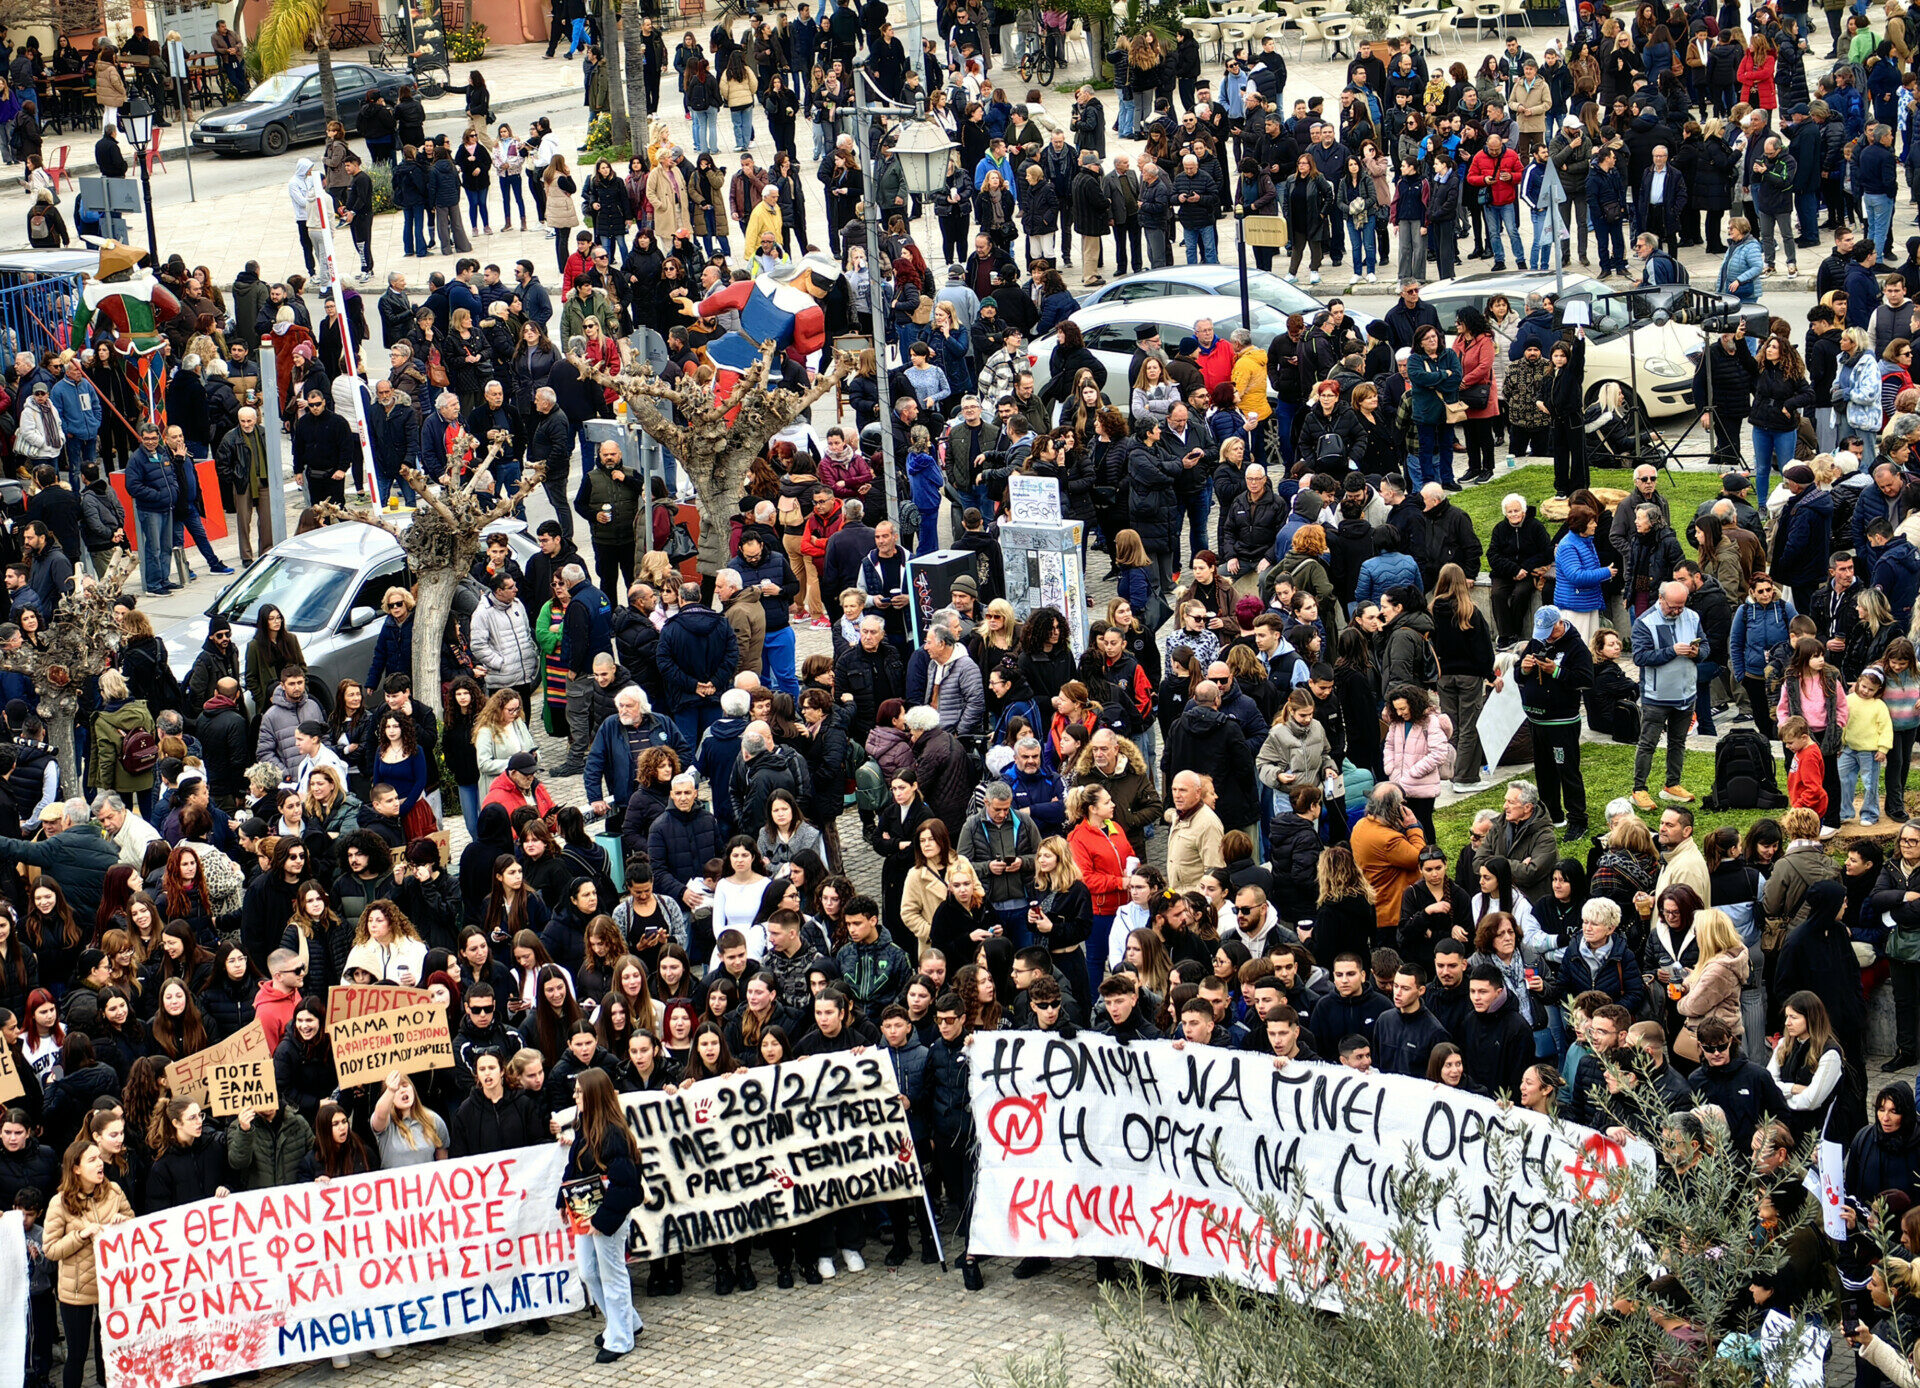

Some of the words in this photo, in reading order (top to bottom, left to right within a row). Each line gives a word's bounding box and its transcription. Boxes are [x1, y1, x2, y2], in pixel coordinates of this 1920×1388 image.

[334, 1017, 388, 1041] ΜΑΜΑ
[397, 1010, 436, 1027] ΜΟΥ
[336, 1034, 393, 1059] ΑΦΑΙΡΕΣΑΝ
[393, 1032, 405, 1044] ΤΟ
[215, 1062, 262, 1080] ΠΟΤΕ
[220, 1080, 263, 1096] ΞΑΝΑ
[340, 1057, 363, 1076] ΠΟΥ
[367, 1051, 387, 1069] ΕΣΥ
[389, 1047, 412, 1064] ΜΟΥ
[413, 1042, 452, 1057] ΧΑΡΙΣΕΣ
[718, 1058, 882, 1120] 28/2/23
[219, 1092, 274, 1110] ΤΕΜΠΗ
[982, 1037, 1025, 1099] Η
[1036, 1039, 1162, 1106] ΘΛΙΨΗ
[1178, 1054, 1253, 1121] ΝΑ
[1272, 1070, 1386, 1146] ΓΙΝΕΙ
[1422, 1100, 1552, 1188] ΟΡΓΗ
[669, 1127, 725, 1170] ΜΕ
[731, 1109, 795, 1151] ΟΤΑΝ
[796, 1094, 905, 1139] ΦΤΑΣΕΙΣ
[1058, 1105, 1103, 1167] Η
[1122, 1112, 1232, 1188] ΟΡΓΗ
[1254, 1134, 1314, 1200] ΝΑ
[686, 1155, 775, 1198] ΡΑΓΕΣ
[787, 1130, 904, 1177] ΓΕΜΙΣΑΝ
[99, 1219, 169, 1269] ΜΑΣ
[184, 1191, 312, 1247] ΘΕΛΑΝ
[385, 1200, 506, 1253] ΝΙΚΗΣΕ
[1008, 1176, 1145, 1242] ΚΑΜΙΑ
[106, 1310, 130, 1339] Ο
[288, 1263, 343, 1306] ΚΑΙ
[359, 1254, 418, 1289] ΟΧΙ
[427, 1247, 449, 1282] Η
[278, 1295, 437, 1356] ΜΑΘΗΤΕΣ
